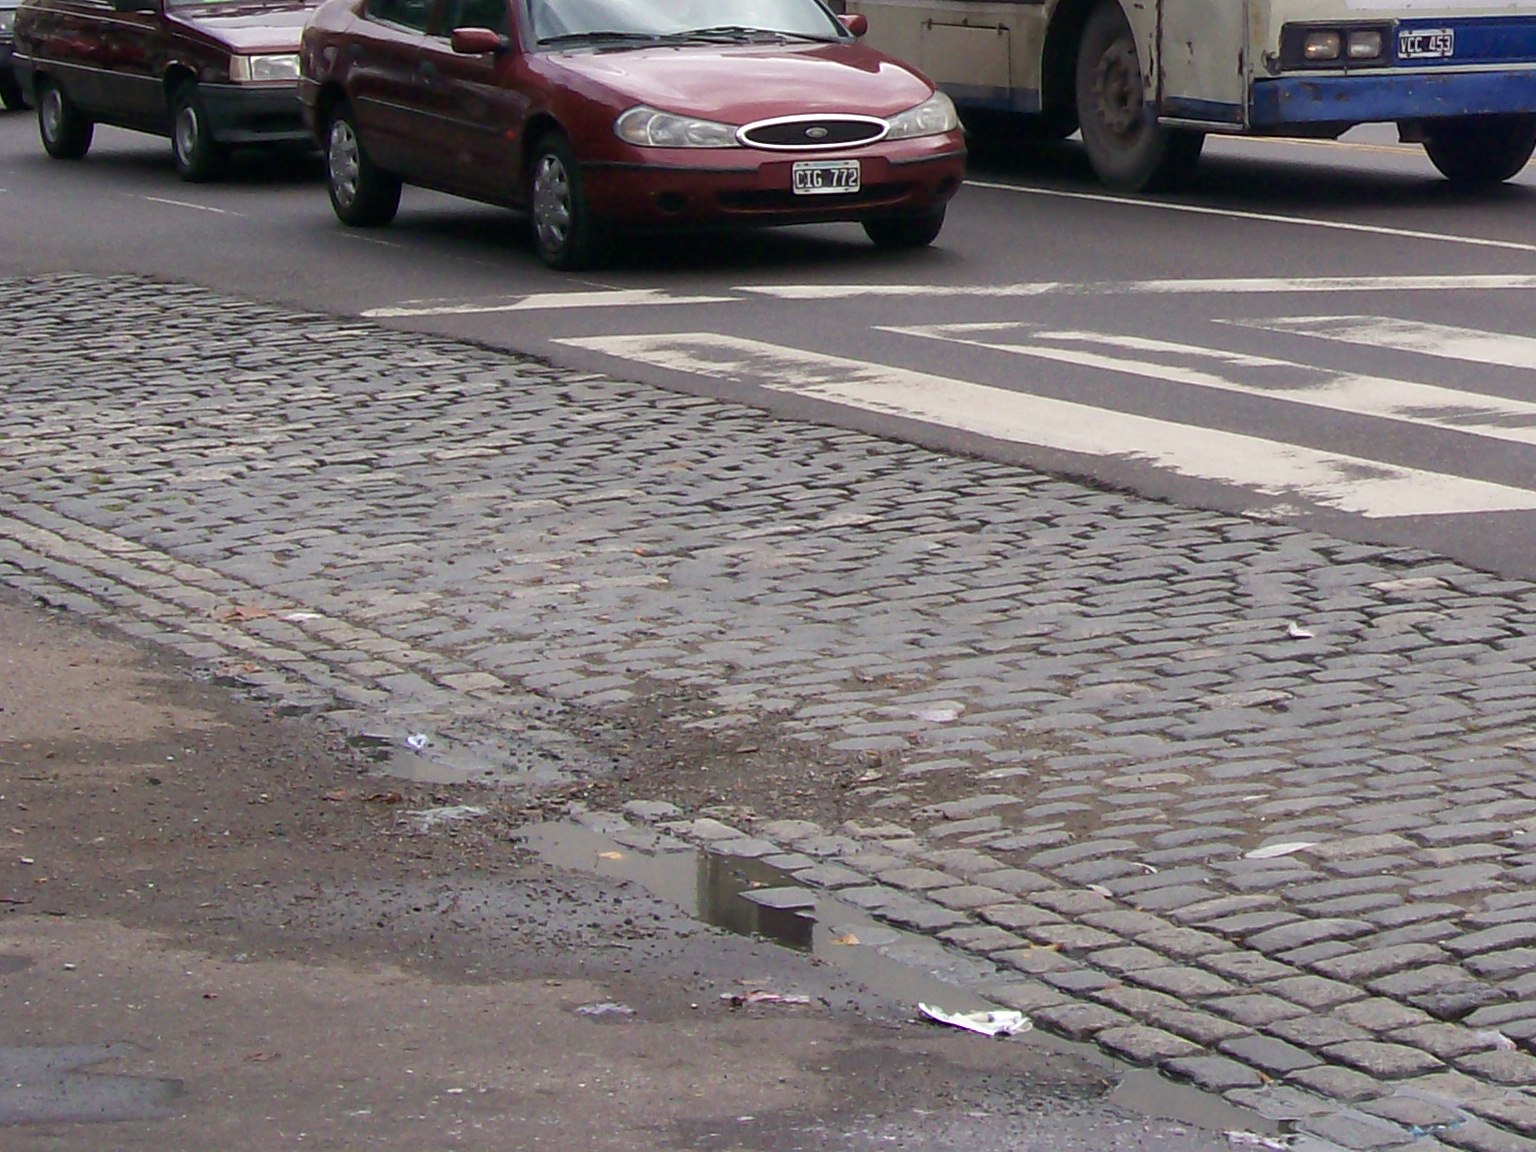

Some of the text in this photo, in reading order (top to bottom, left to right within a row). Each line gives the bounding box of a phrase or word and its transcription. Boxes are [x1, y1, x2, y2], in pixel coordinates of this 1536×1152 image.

[1400, 36, 1451, 53] VCC 453
[795, 168, 857, 188] CIG 772
